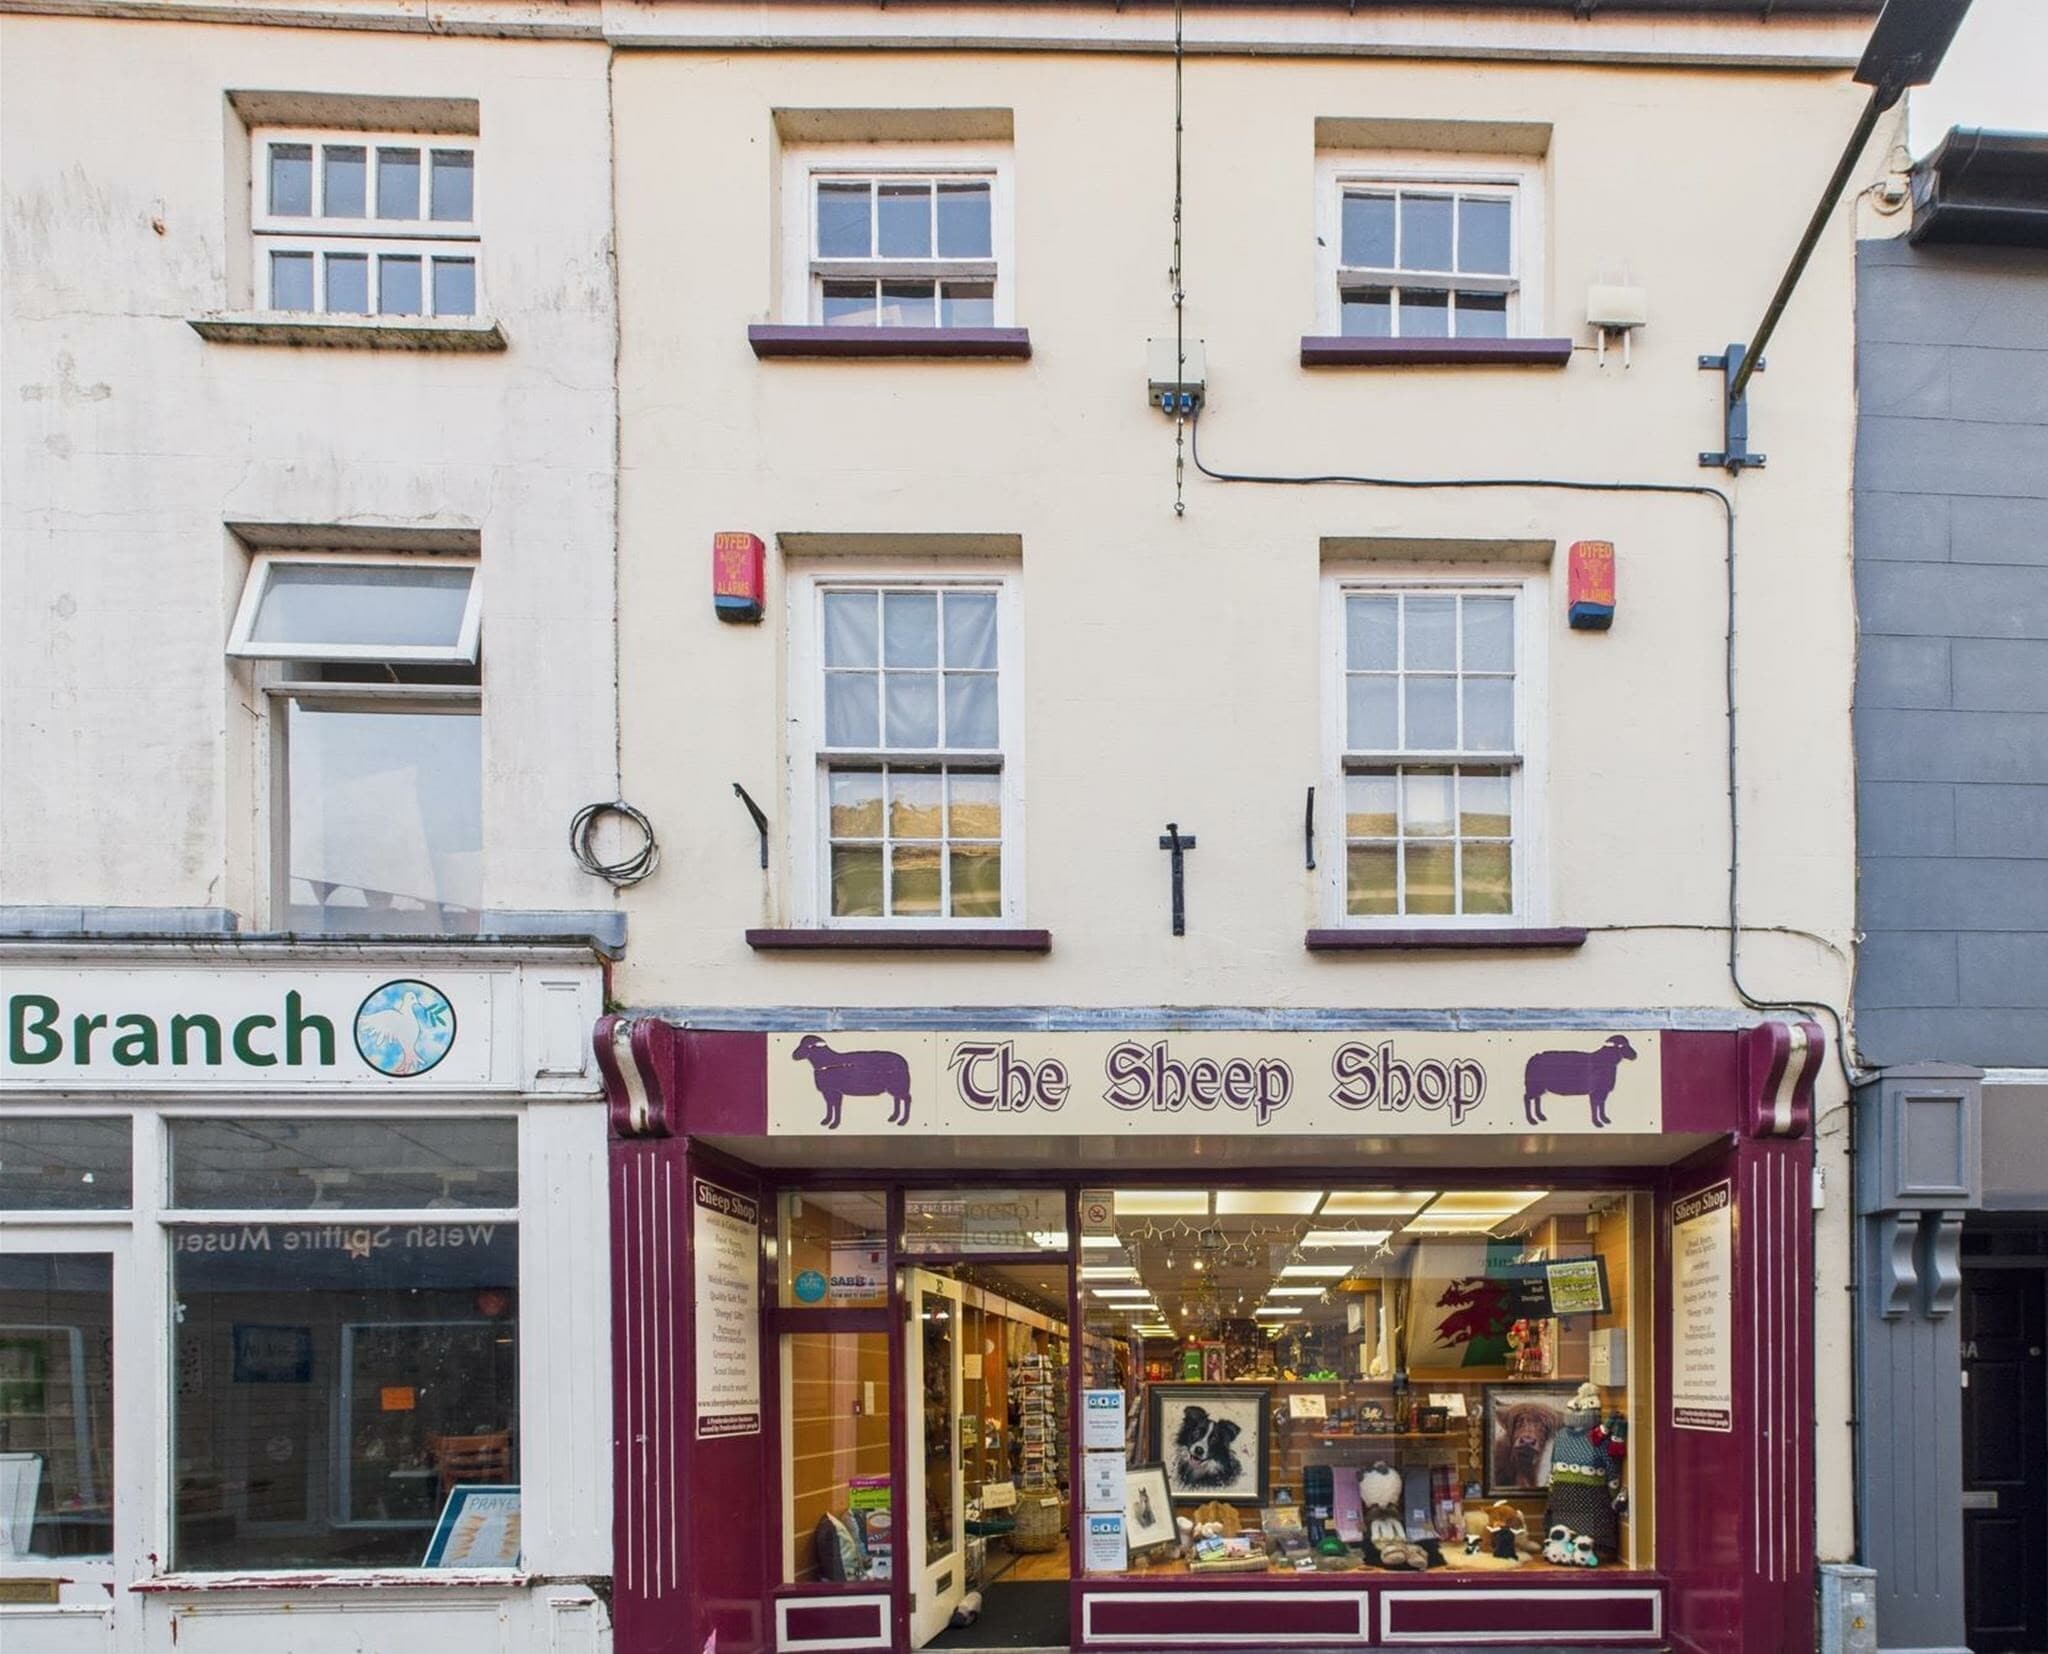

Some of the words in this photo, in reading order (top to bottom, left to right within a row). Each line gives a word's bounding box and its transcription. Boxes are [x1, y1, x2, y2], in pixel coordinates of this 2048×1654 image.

[716, 534, 750, 549] DYFED
[1579, 543, 1612, 559] DYFED
[10, 989, 335, 1066] Branch
[947, 1041, 1071, 1113] The
[1103, 1040, 1295, 1127] Sheep
[1329, 1040, 1487, 1127] Shop
[698, 1185, 731, 1213] Sheep
[731, 1198, 756, 1221] Shop
[1675, 1199, 1702, 1220] Sheep
[1702, 1189, 1727, 1210] Shop
